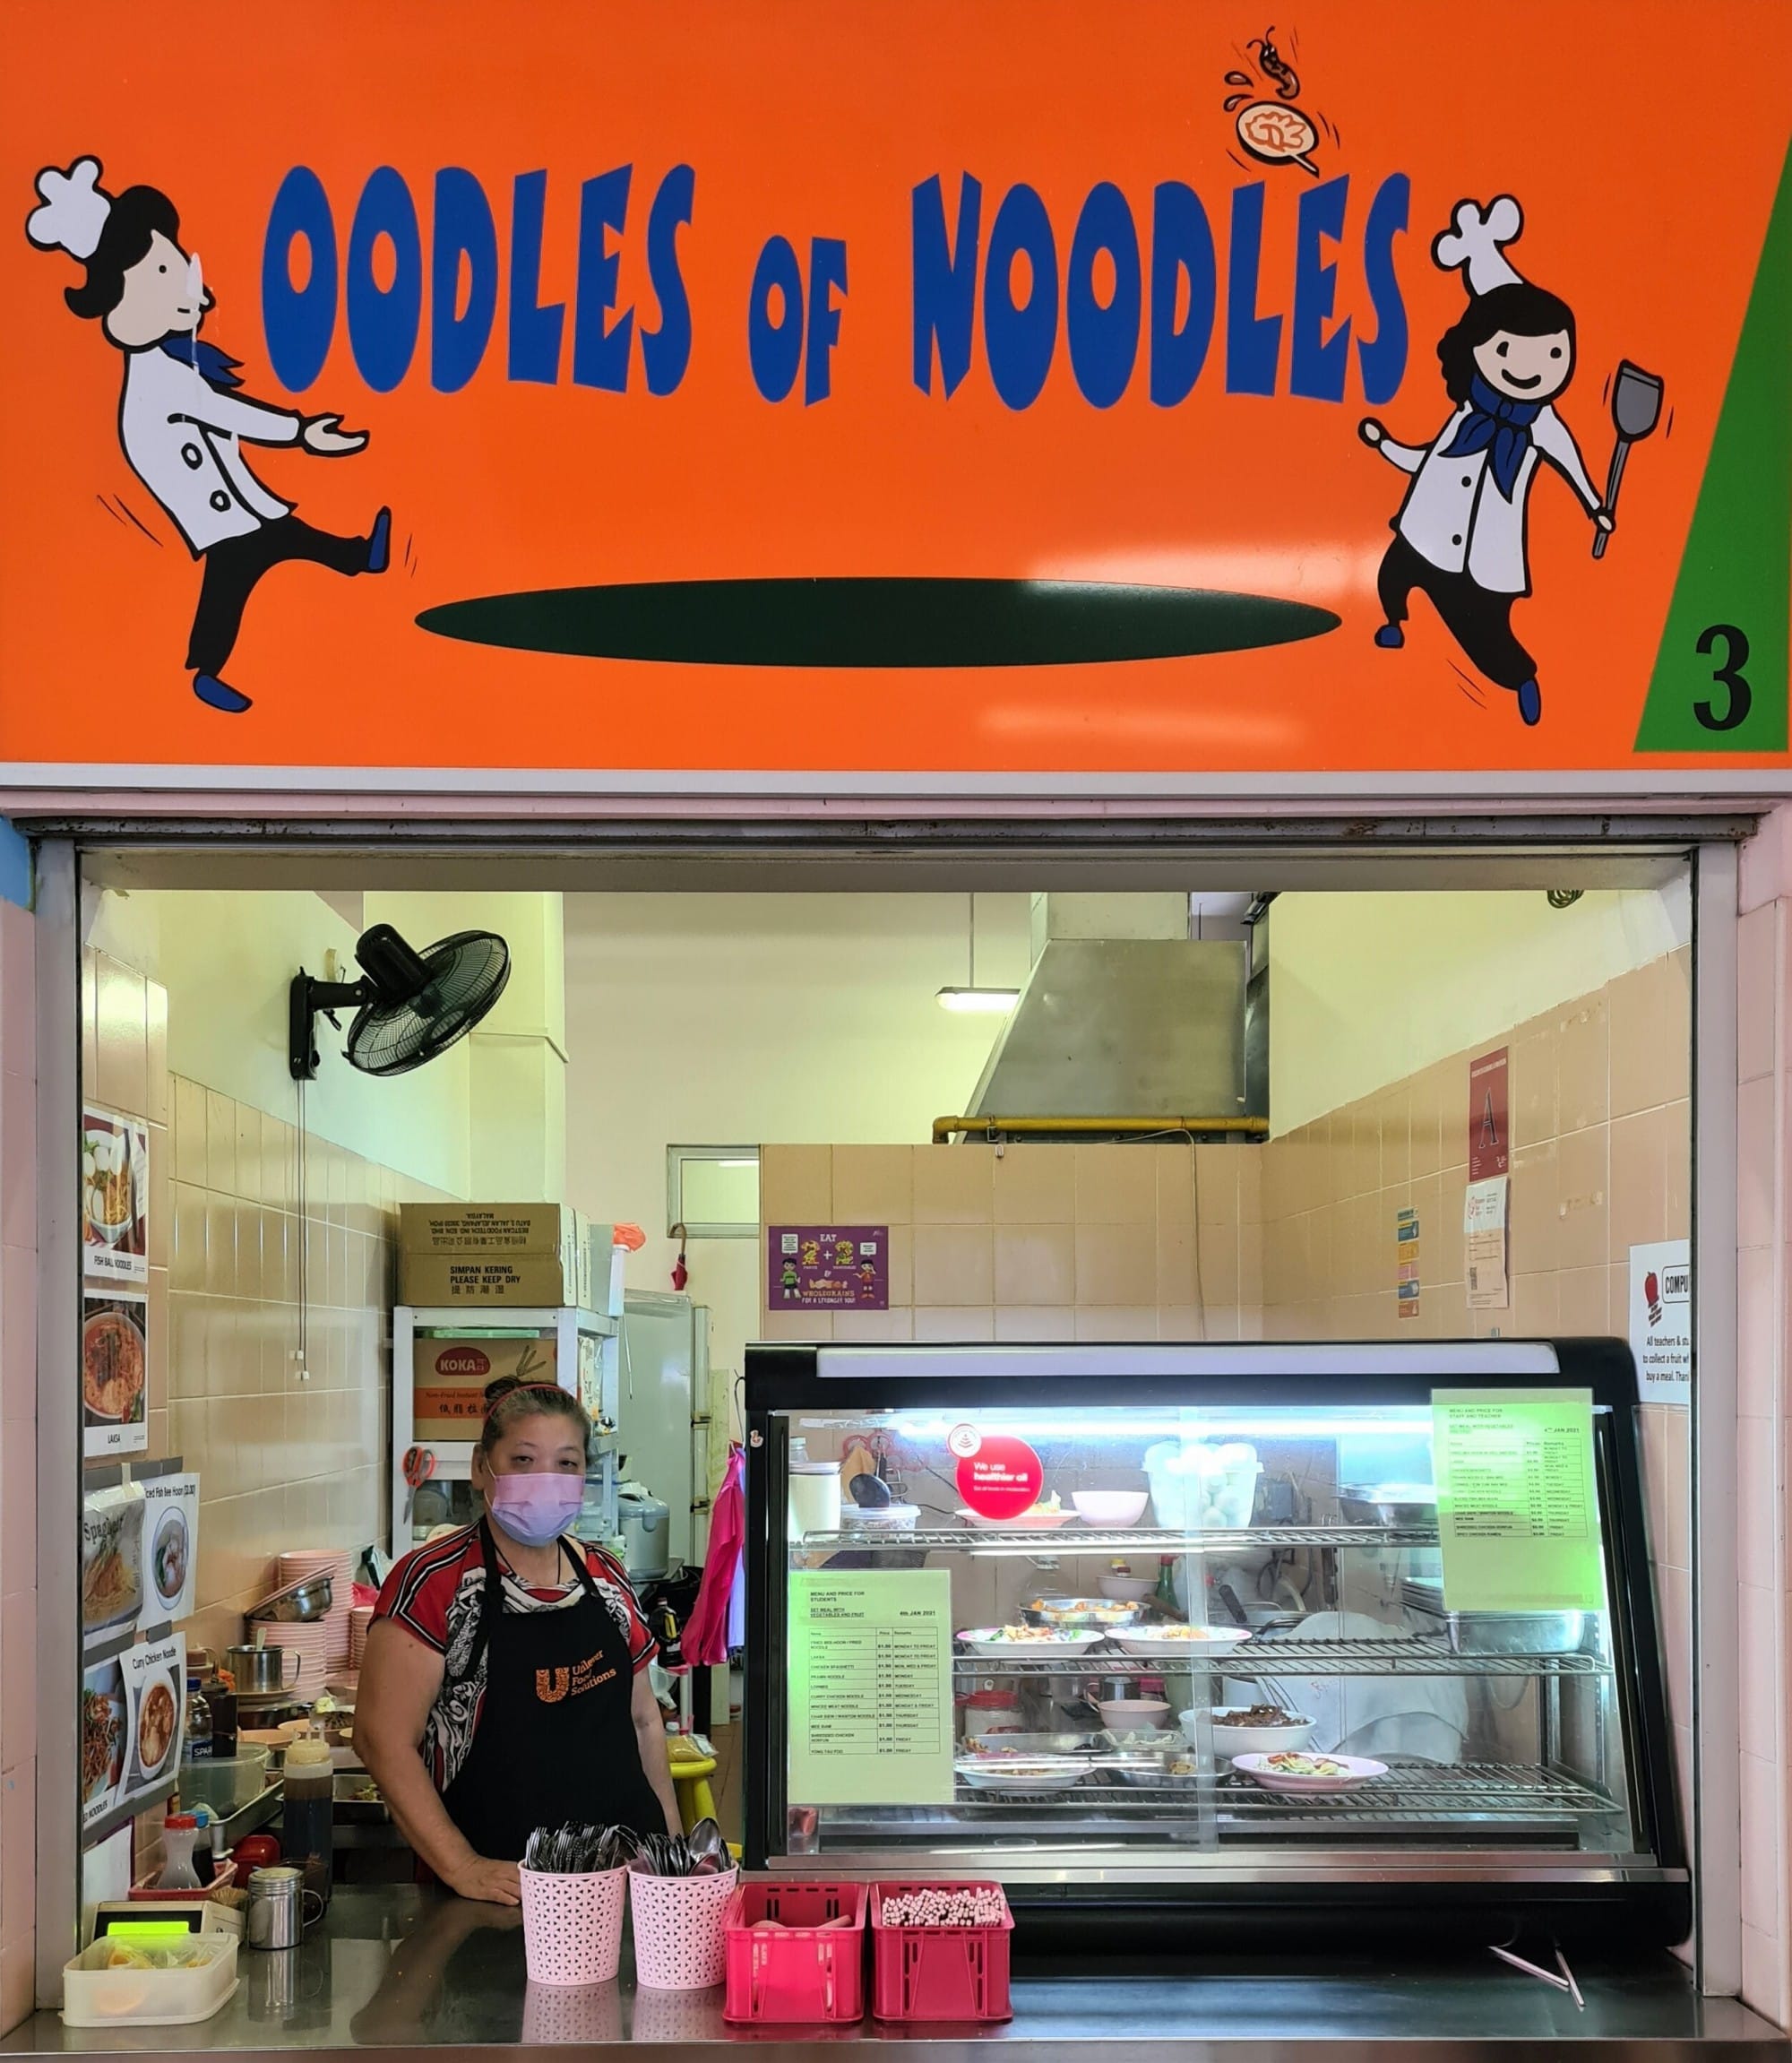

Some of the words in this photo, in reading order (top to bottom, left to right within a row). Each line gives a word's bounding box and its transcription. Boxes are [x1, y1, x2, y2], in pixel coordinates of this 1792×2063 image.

[262, 162, 696, 397] OODLES
[748, 235, 849, 408] OF
[911, 170, 1411, 411] NOODLES
[1693, 623, 1753, 732] 3
[1479, 1086, 1499, 1150] A
[820, 1234, 837, 1242] EAT
[801, 1240, 820, 1265] 2
[834, 1240, 854, 1265] 2
[450, 1265, 481, 1273] SIMPAN
[485, 1265, 513, 1273] KERING
[450, 1275, 478, 1283] PLEASE
[482, 1275, 502, 1283] KEEP
[505, 1275, 521, 1283] DRY
[440, 1359, 476, 1371] KOKA
[973, 1462, 988, 1471] We
[973, 1472, 1015, 1481] healthier
[1016, 1472, 1028, 1481] oil
